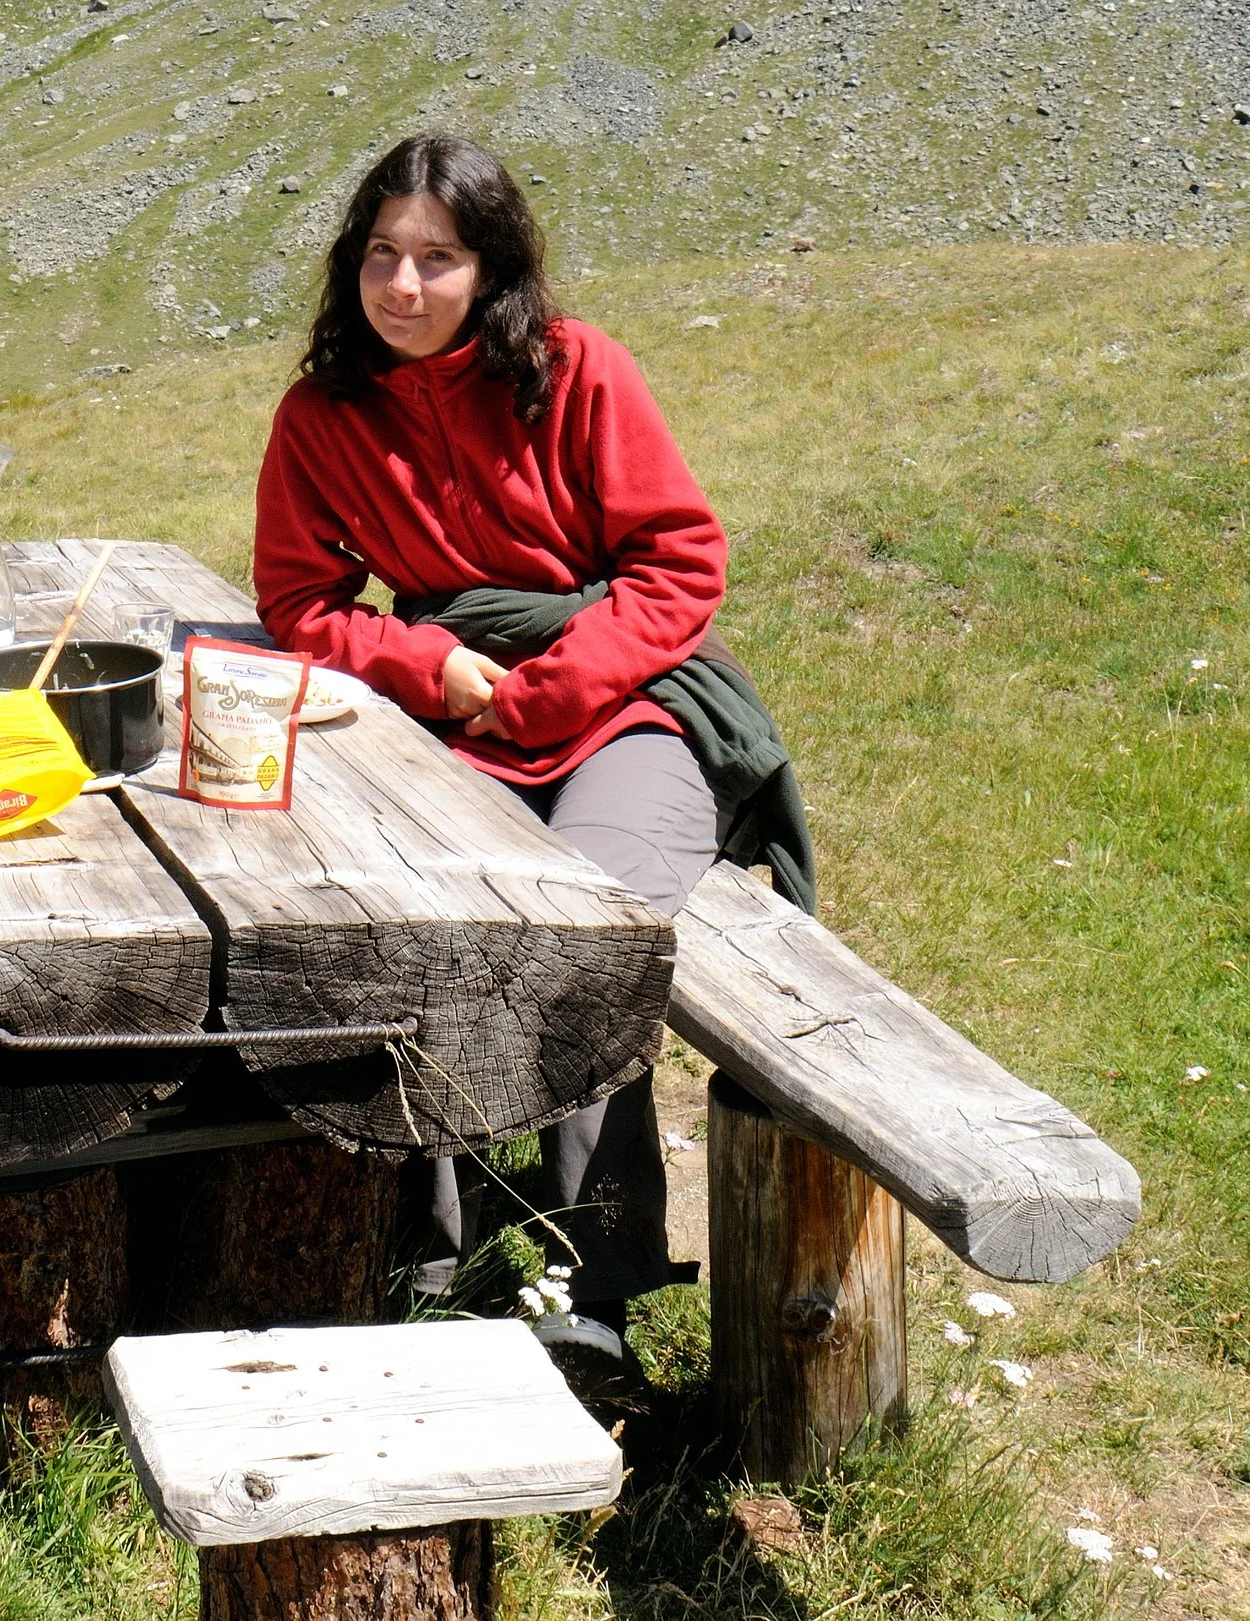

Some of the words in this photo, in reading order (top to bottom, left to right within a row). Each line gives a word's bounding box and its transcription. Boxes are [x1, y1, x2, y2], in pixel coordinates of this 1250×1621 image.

[197, 676, 230, 696] GRAN
[202, 710, 234, 722] GRANA
[236, 715, 272, 725] PADANO
